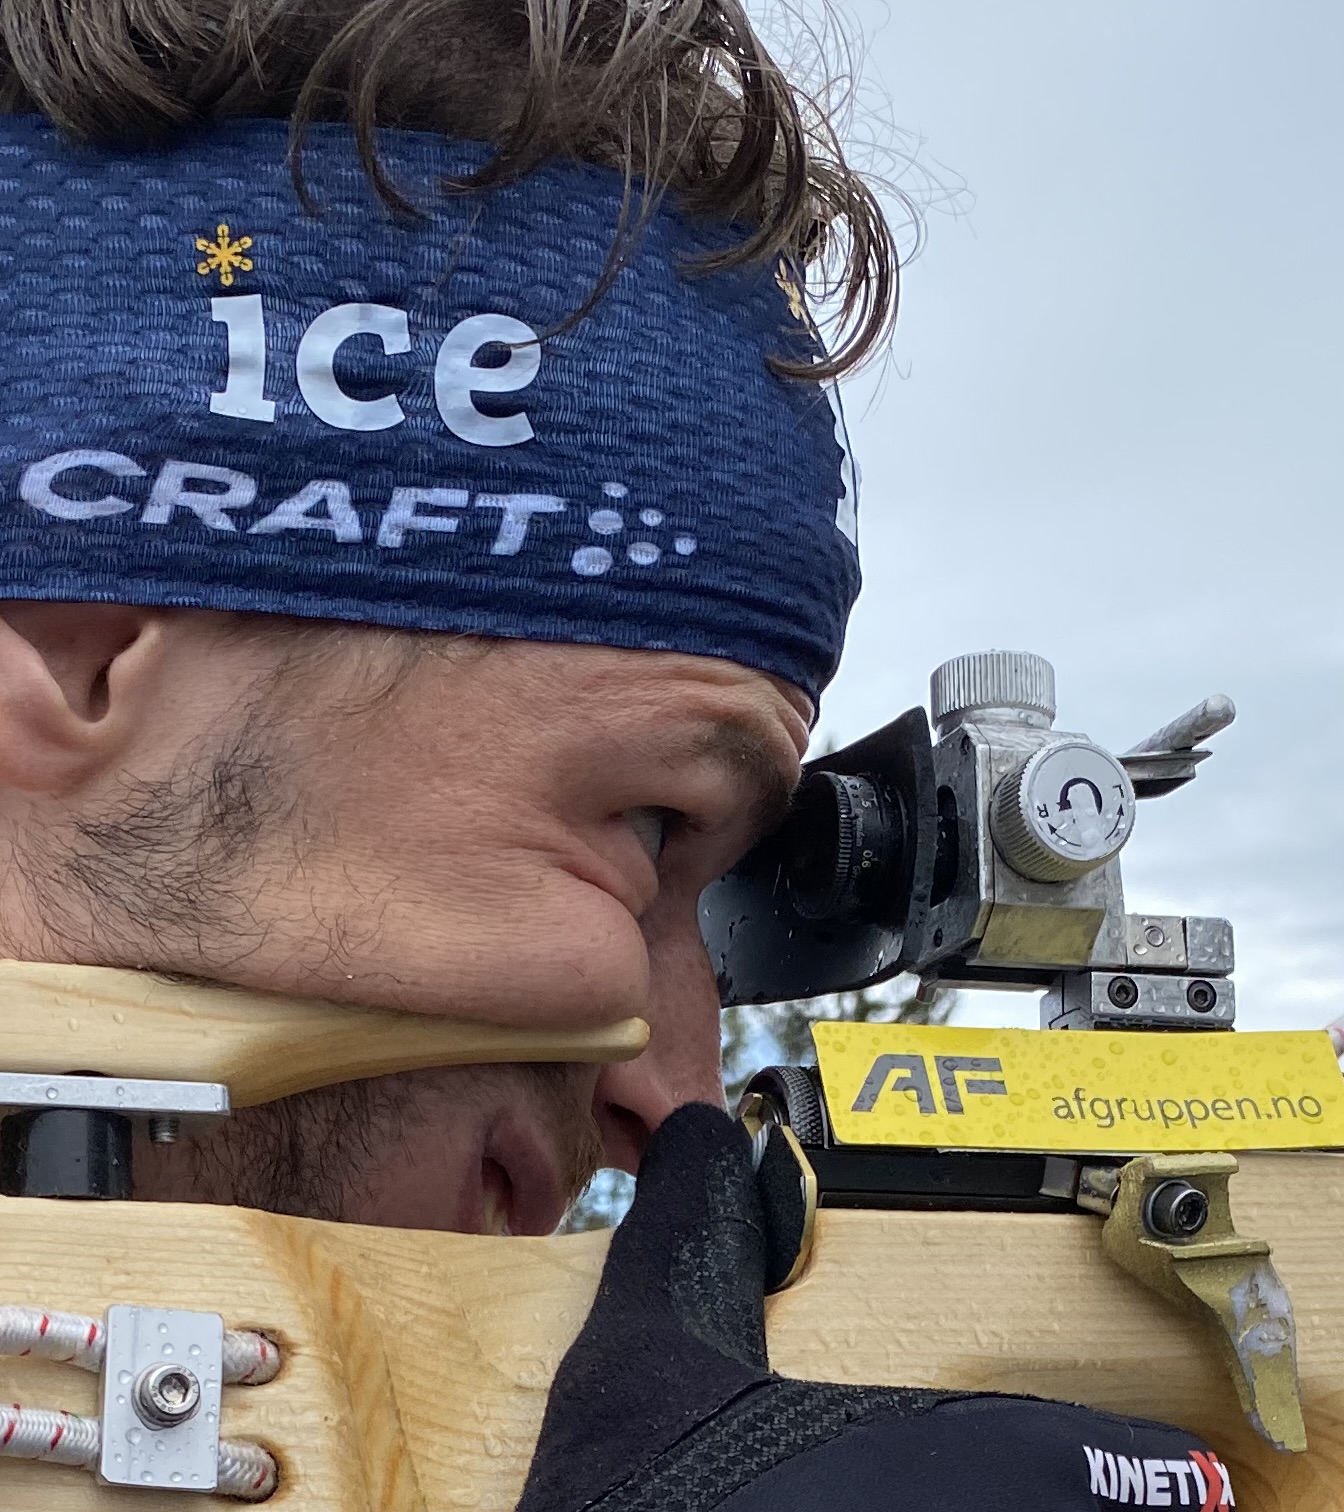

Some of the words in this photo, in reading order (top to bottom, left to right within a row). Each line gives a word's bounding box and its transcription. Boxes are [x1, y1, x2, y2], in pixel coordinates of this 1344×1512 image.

[209, 293, 543, 447] ice
[18, 448, 567, 556] CRAFT
[851, 1054, 1008, 1115] AF
[1052, 1086, 1323, 1129] afgruppen.no
